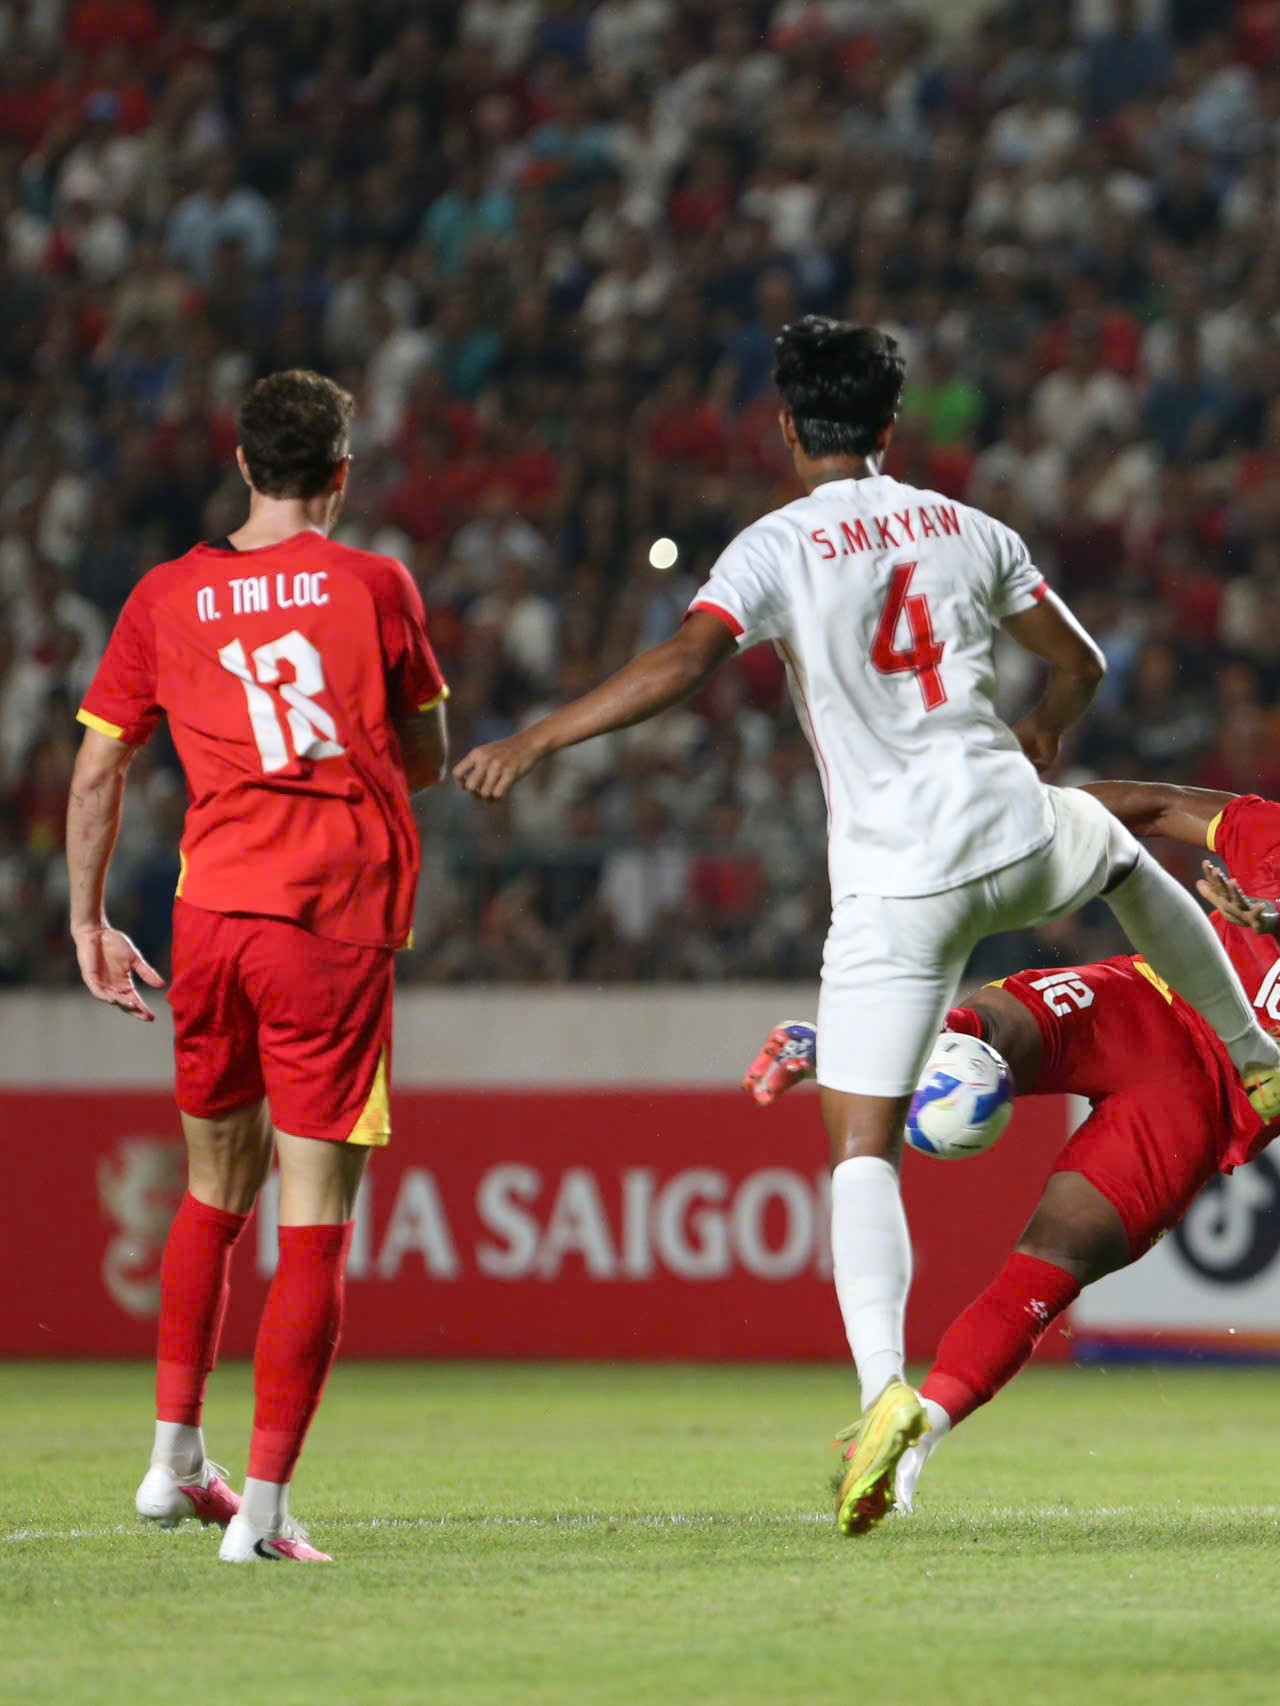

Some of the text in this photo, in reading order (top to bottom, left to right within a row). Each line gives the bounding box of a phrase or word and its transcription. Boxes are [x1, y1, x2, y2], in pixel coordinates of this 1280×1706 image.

[811, 505, 961, 560] S.M.KYAW
[228, 575, 269, 615] TAI
[276, 571, 329, 609] LOC
[869, 561, 948, 712] 4
[1029, 971, 1095, 1018] 12
[474, 1161, 840, 1282] SAIGO
